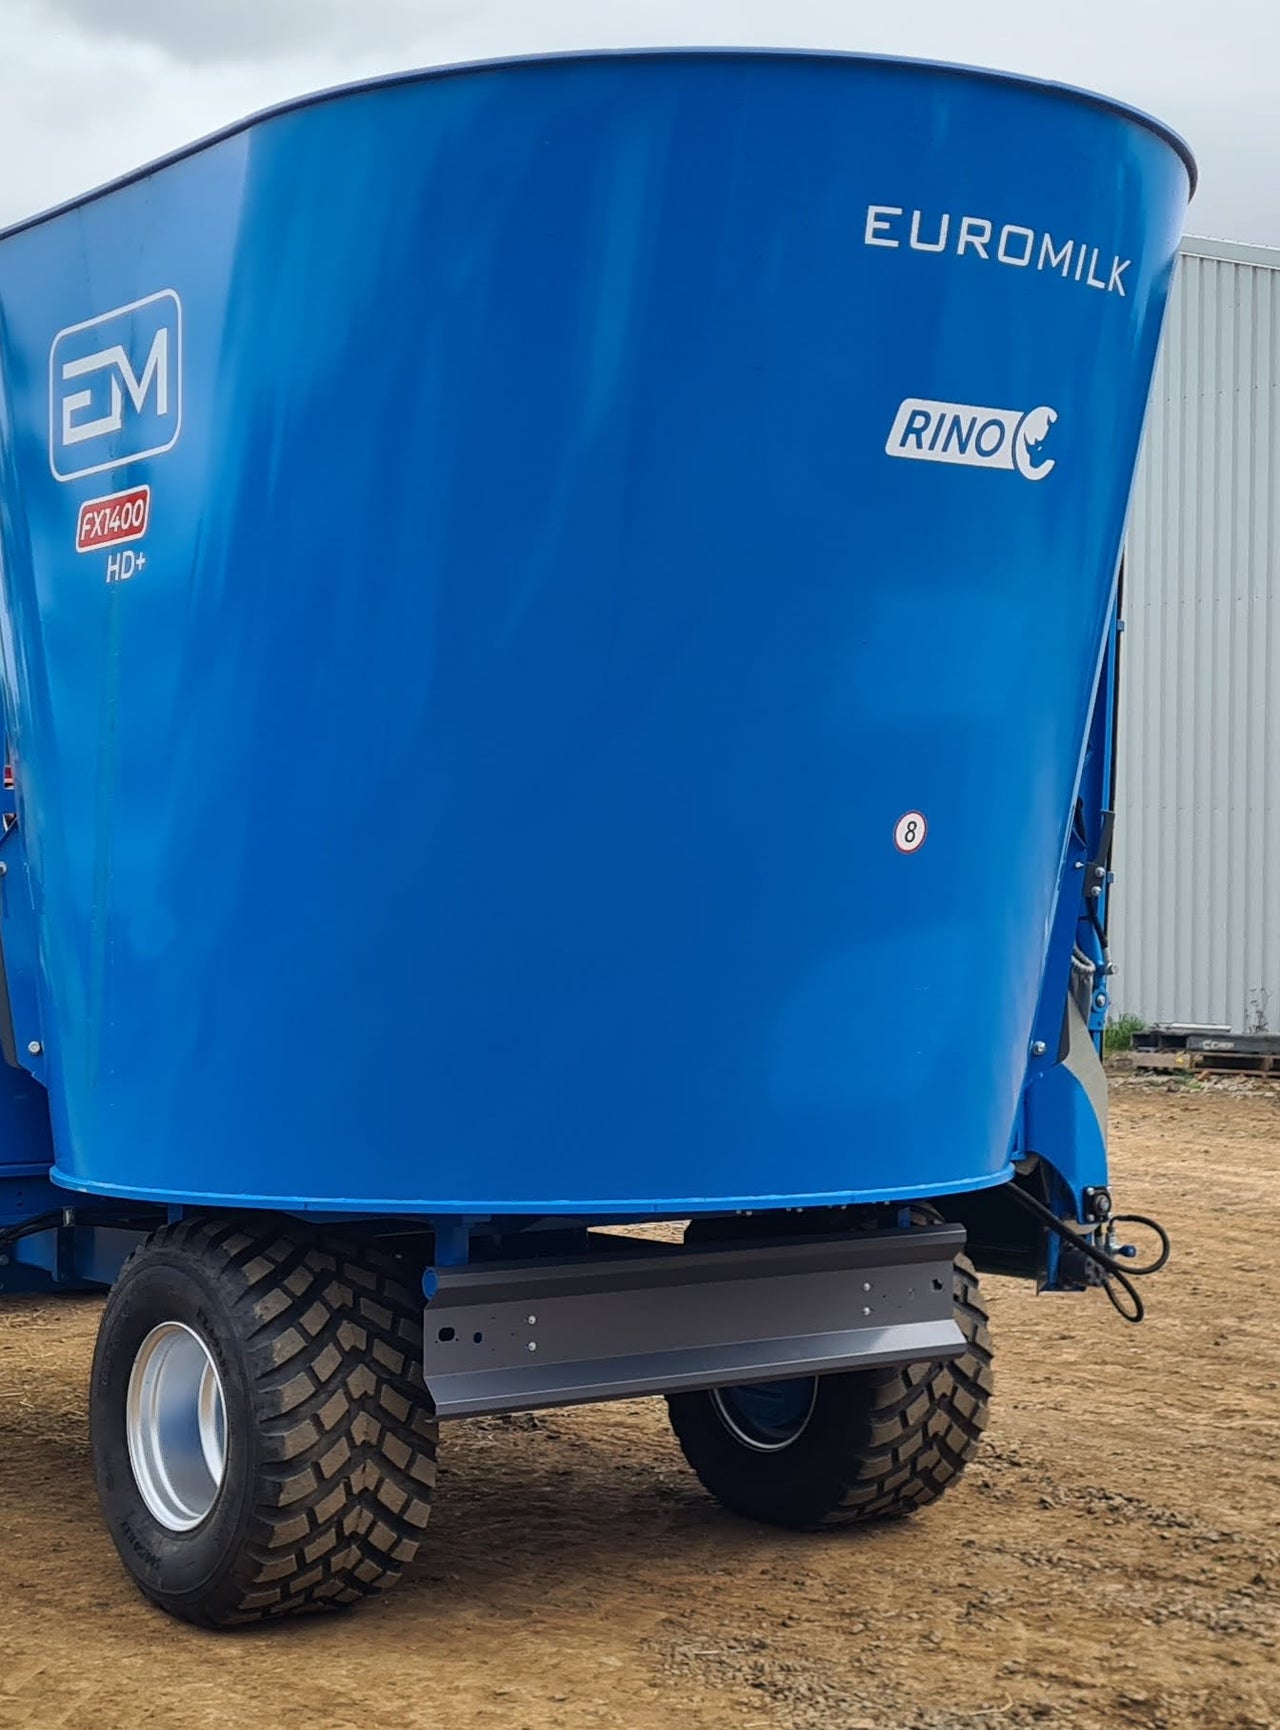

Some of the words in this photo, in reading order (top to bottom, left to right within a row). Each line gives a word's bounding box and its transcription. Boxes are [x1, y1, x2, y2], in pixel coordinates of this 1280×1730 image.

[864, 205, 1131, 297] EUROMILK
[62, 328, 168, 446] EM
[899, 409, 1006, 457] RINO
[80, 498, 145, 541] FX1400
[106, 550, 146, 583] HD+
[905, 821, 917, 843] 8
